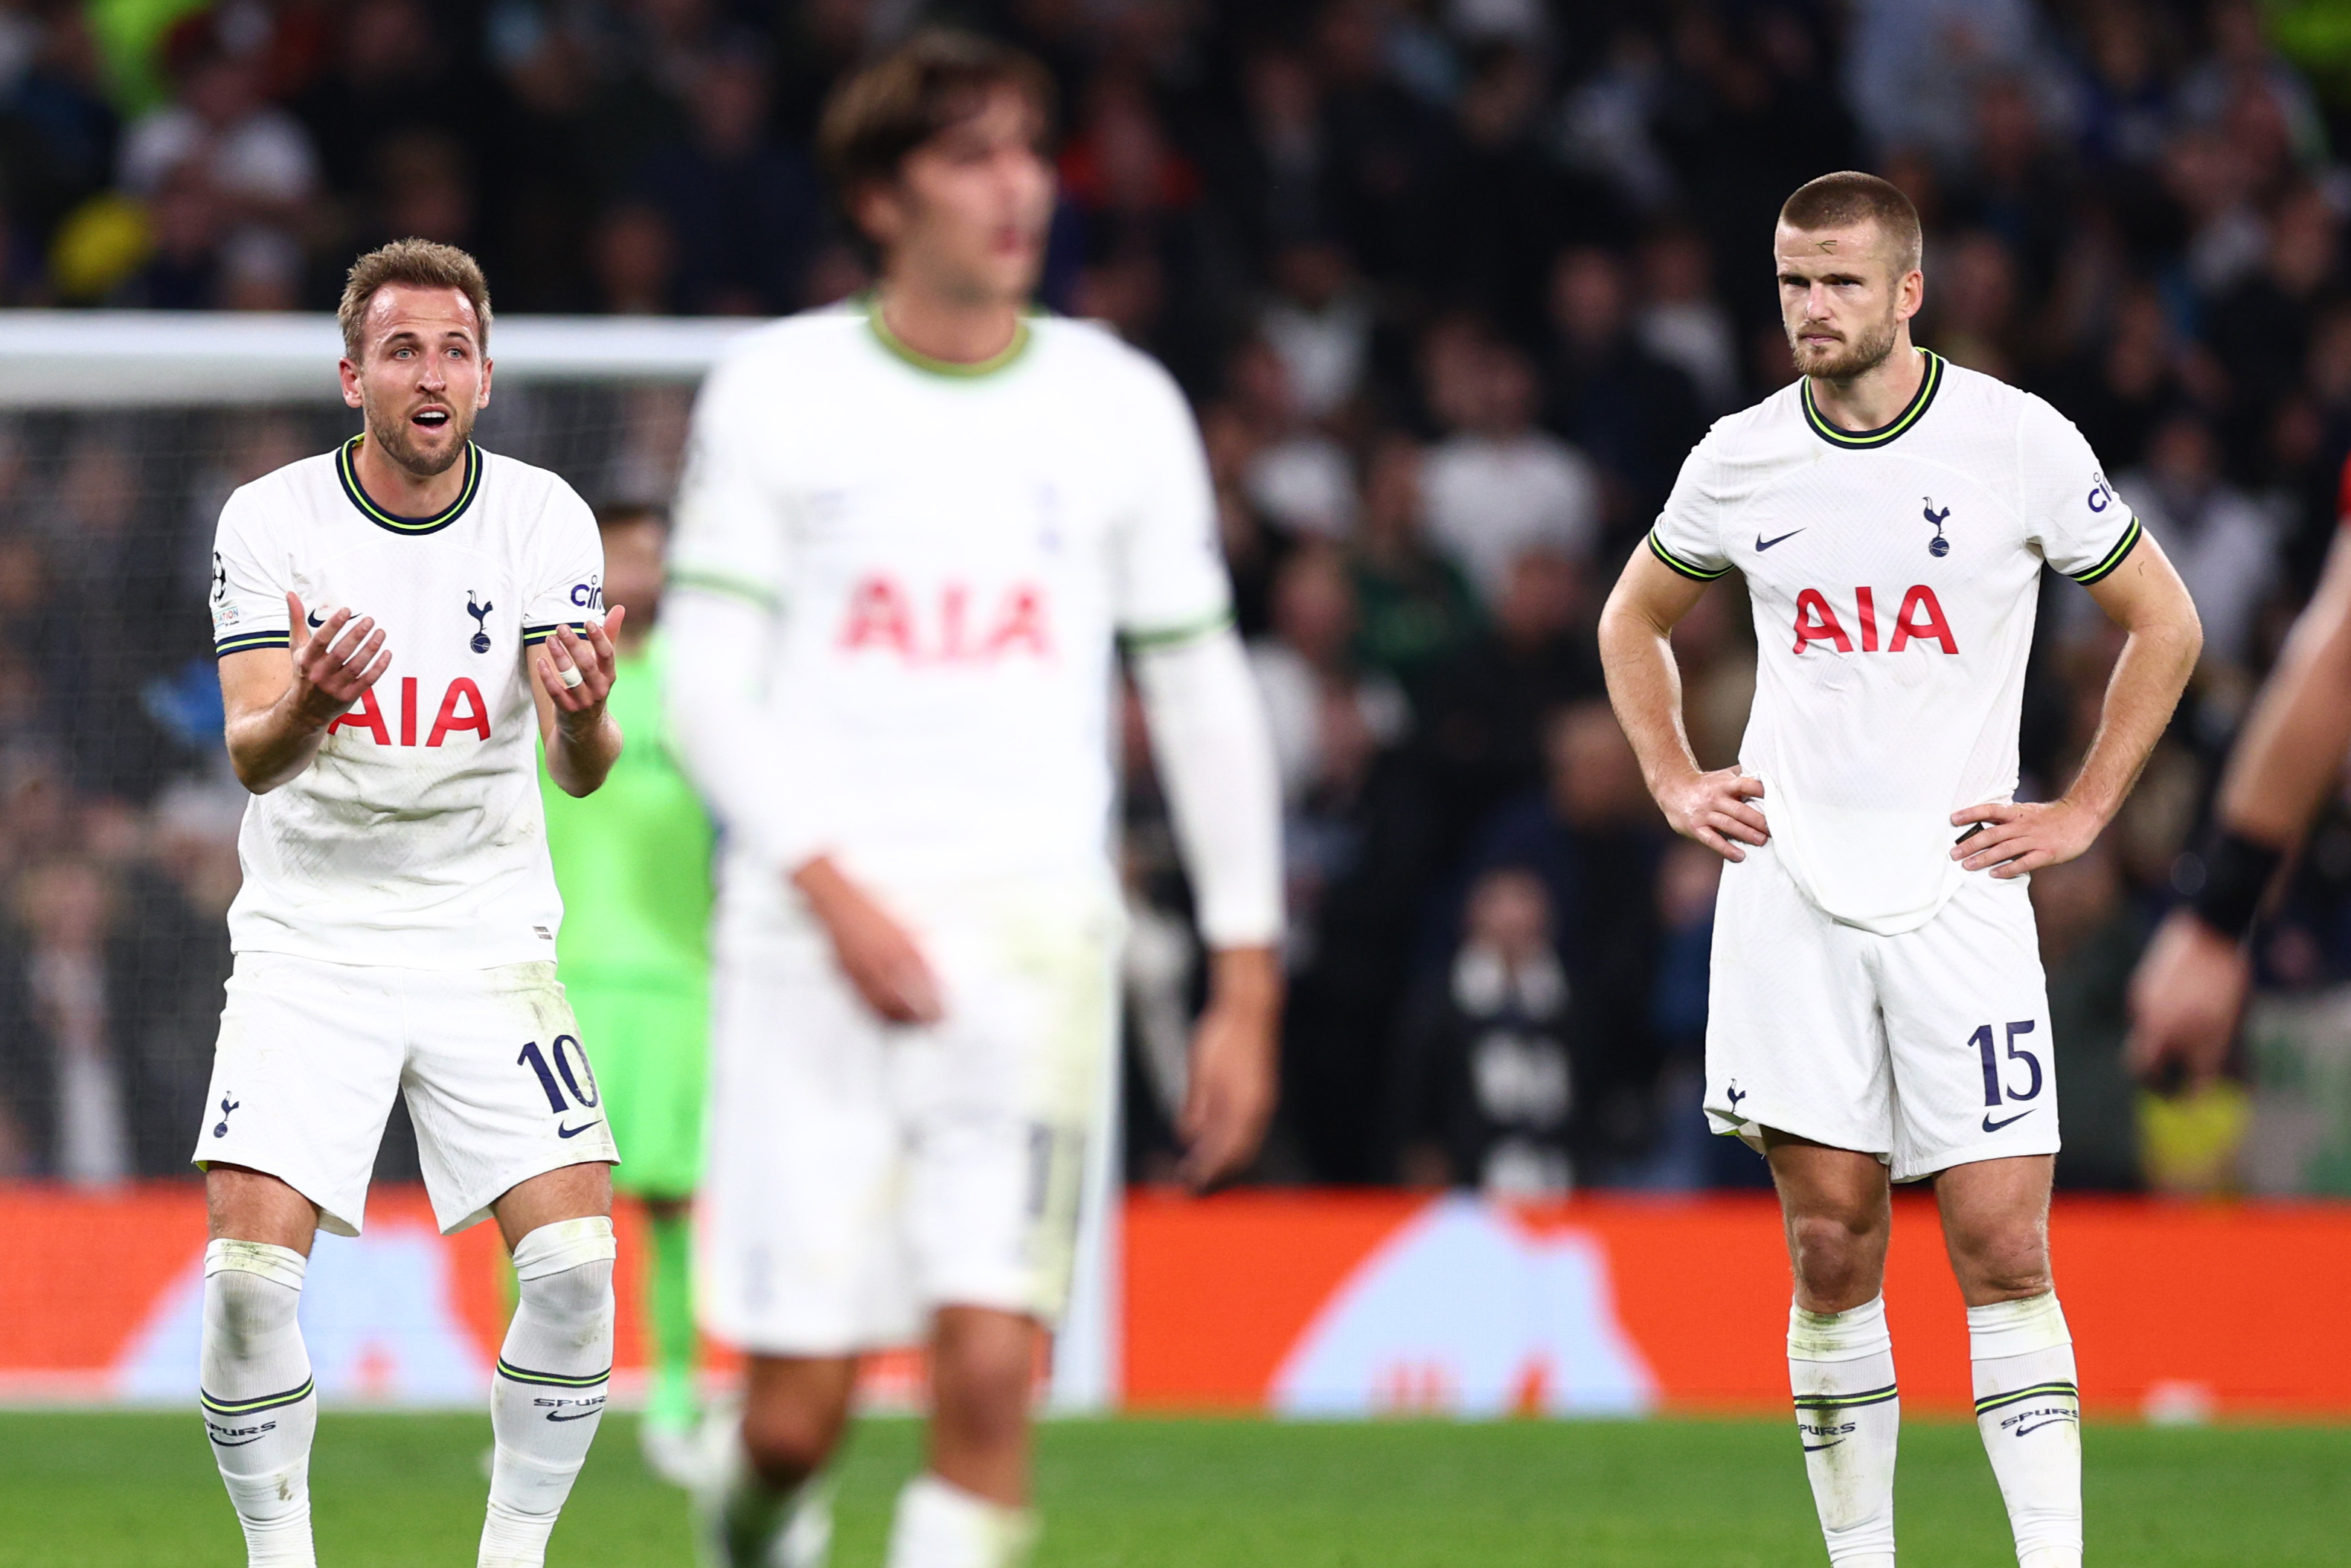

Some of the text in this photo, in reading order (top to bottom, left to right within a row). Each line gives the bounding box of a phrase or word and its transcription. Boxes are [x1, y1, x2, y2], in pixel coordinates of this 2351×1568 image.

[838, 574, 1048, 661] AIA
[1794, 585, 1959, 655] AIA
[327, 677, 491, 748] AIA
[516, 1034, 597, 1114] 10
[1967, 1019, 2043, 1107] 15
[205, 1418, 276, 1436] PURS
[533, 1395, 607, 1407] SPUR
[1798, 1421, 1856, 1436] PURS
